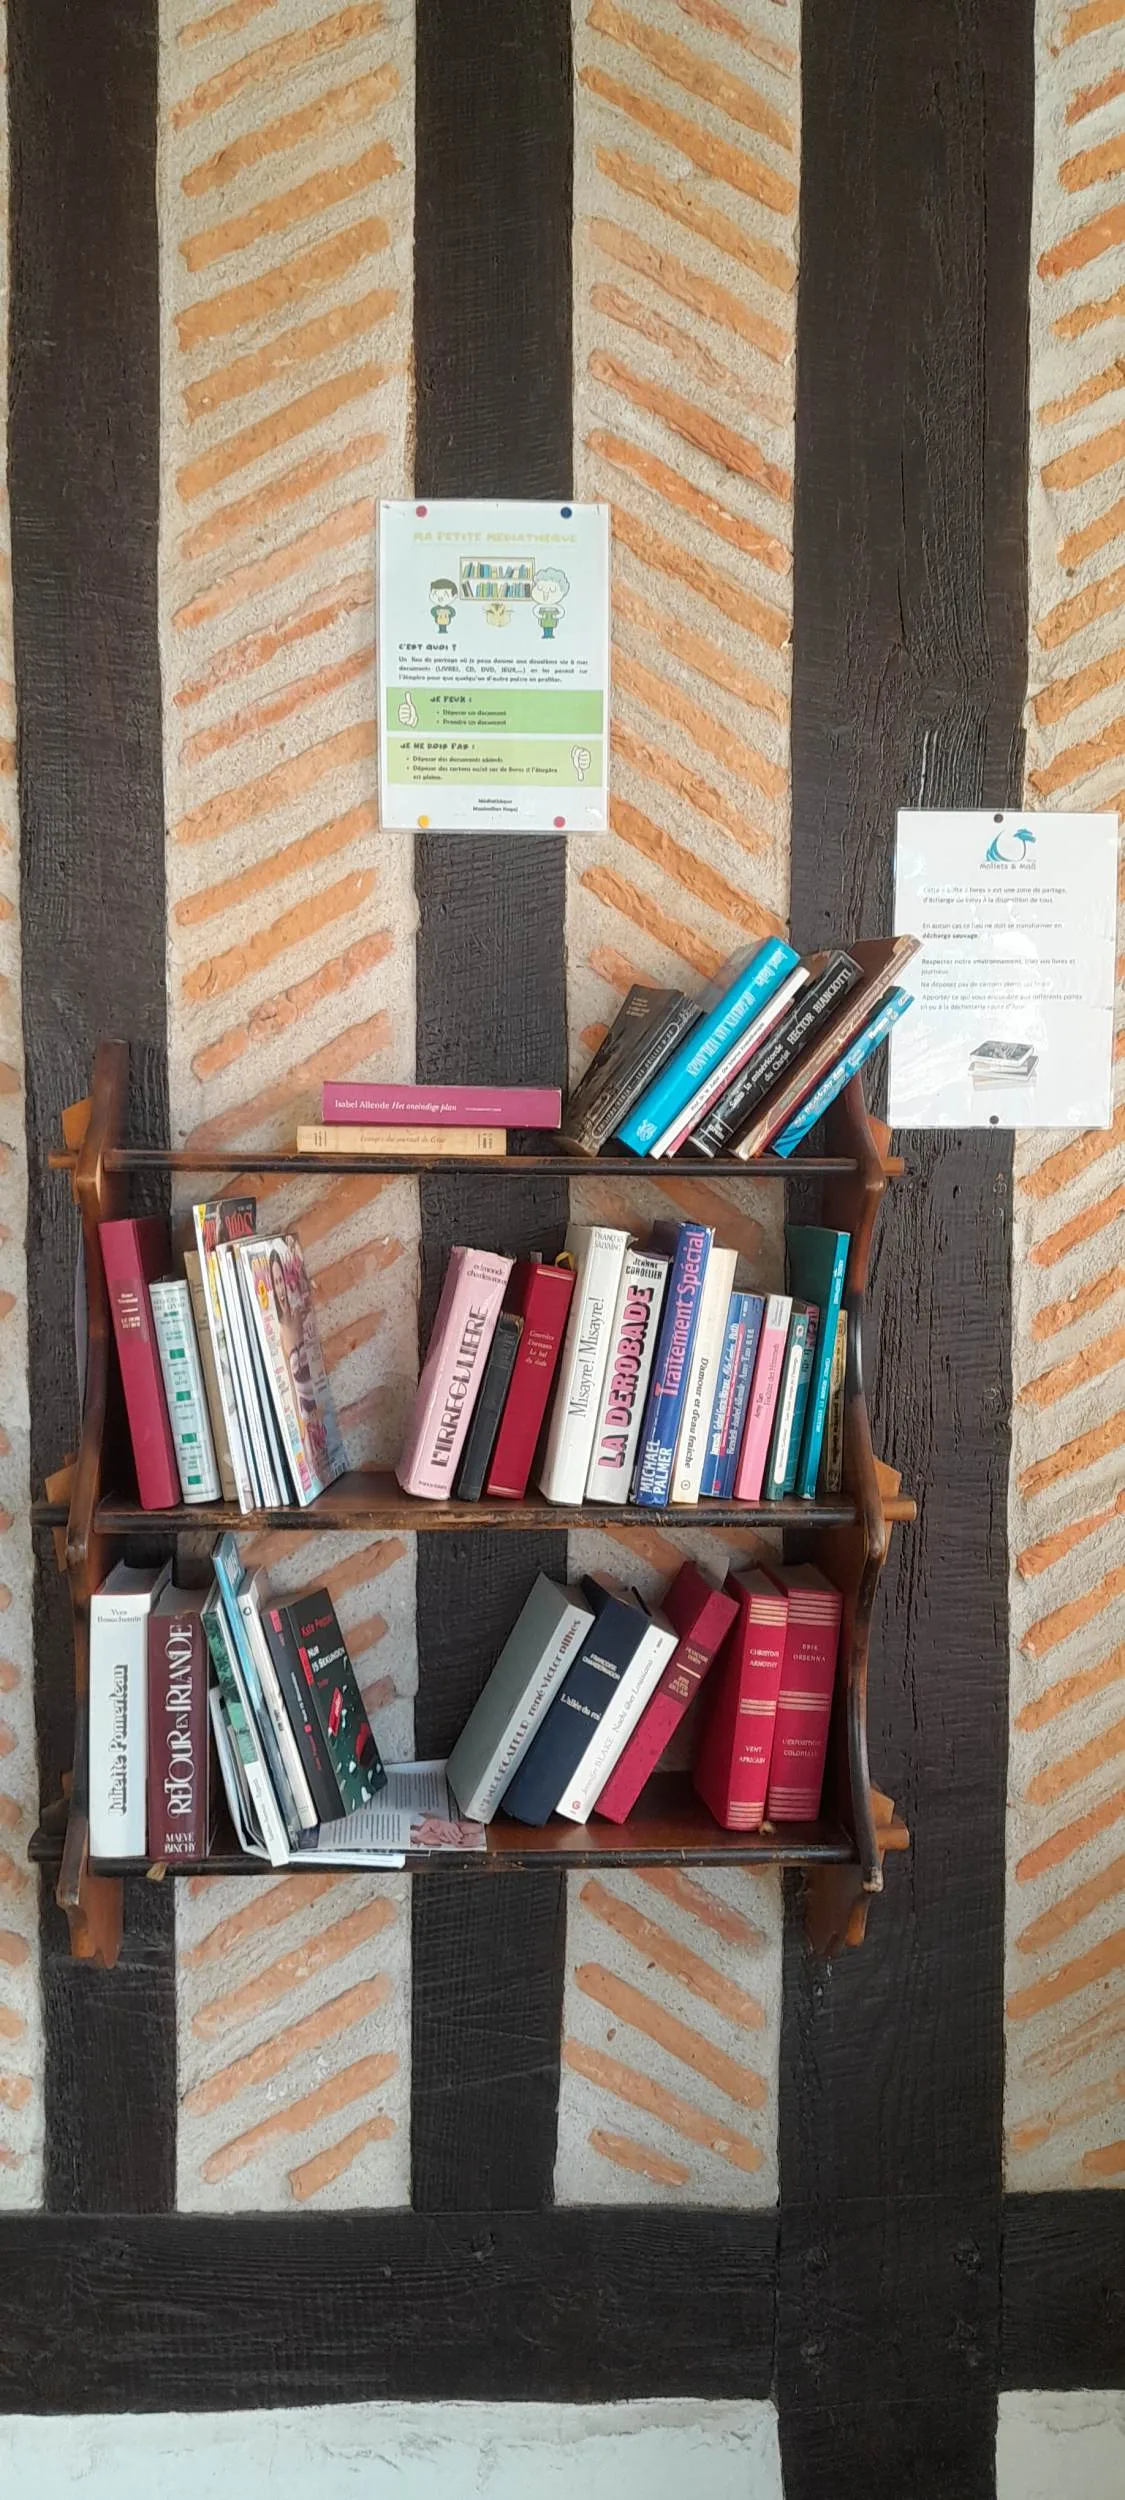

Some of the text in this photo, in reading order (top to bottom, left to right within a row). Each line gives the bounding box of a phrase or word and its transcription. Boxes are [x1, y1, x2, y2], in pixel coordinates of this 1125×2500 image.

[413, 531, 432, 541] MA
[438, 531, 482, 542] PETITE
[452, 644, 457, 652] ?
[980, 862, 1008, 870] Moliets
[785, 1010, 816, 1046] HECTOR
[810, 966, 853, 1014] BIANCIOTTI
[761, 1047, 792, 1082] du Christ
[727, 1041, 784, 1110] Sans la miséricorde
[335, 1099, 358, 1108] Isabel
[359, 1100, 389, 1109] Allende
[391, 1101, 404, 1109] Het
[405, 1102, 439, 1112] oneindige
[440, 1103, 456, 1113] plan
[632, 1258, 658, 1268] JEANNE
[626, 1266, 663, 1280] CORDELIER
[654, 1231, 705, 1397] Traitement Spécial
[568, 1297, 604, 1418] Misayre! Misayre!
[741, 1346, 750, 1360] Tan
[595, 1284, 654, 1469] LA DEROBADE
[738, 1362, 751, 1379] Amy
[689, 1357, 709, 1434] D'amour et d'eau
[753, 1392, 763, 1418] Amy Tan
[640, 1439, 661, 1494] MICHAEL
[652, 1447, 673, 1495] PALMER
[110, 1608, 128, 1616] Yves
[793, 1653, 826, 1662] ORSENNA
[525, 1687, 546, 1716] rené
[538, 1653, 564, 1691] victor
[582, 1704, 591, 1714] du
[164, 1624, 195, 1817] RETOUR EN IRLANDE
[108, 1664, 129, 1816] Juliette Pomerleau
[594, 1737, 611, 1766] BLAKE
[745, 1745, 762, 1754] VENT
[739, 1755, 766, 1764] AFRICAIN
[165, 1832, 194, 1842] MAEVE
[164, 1842, 196, 1854] BINCHY
